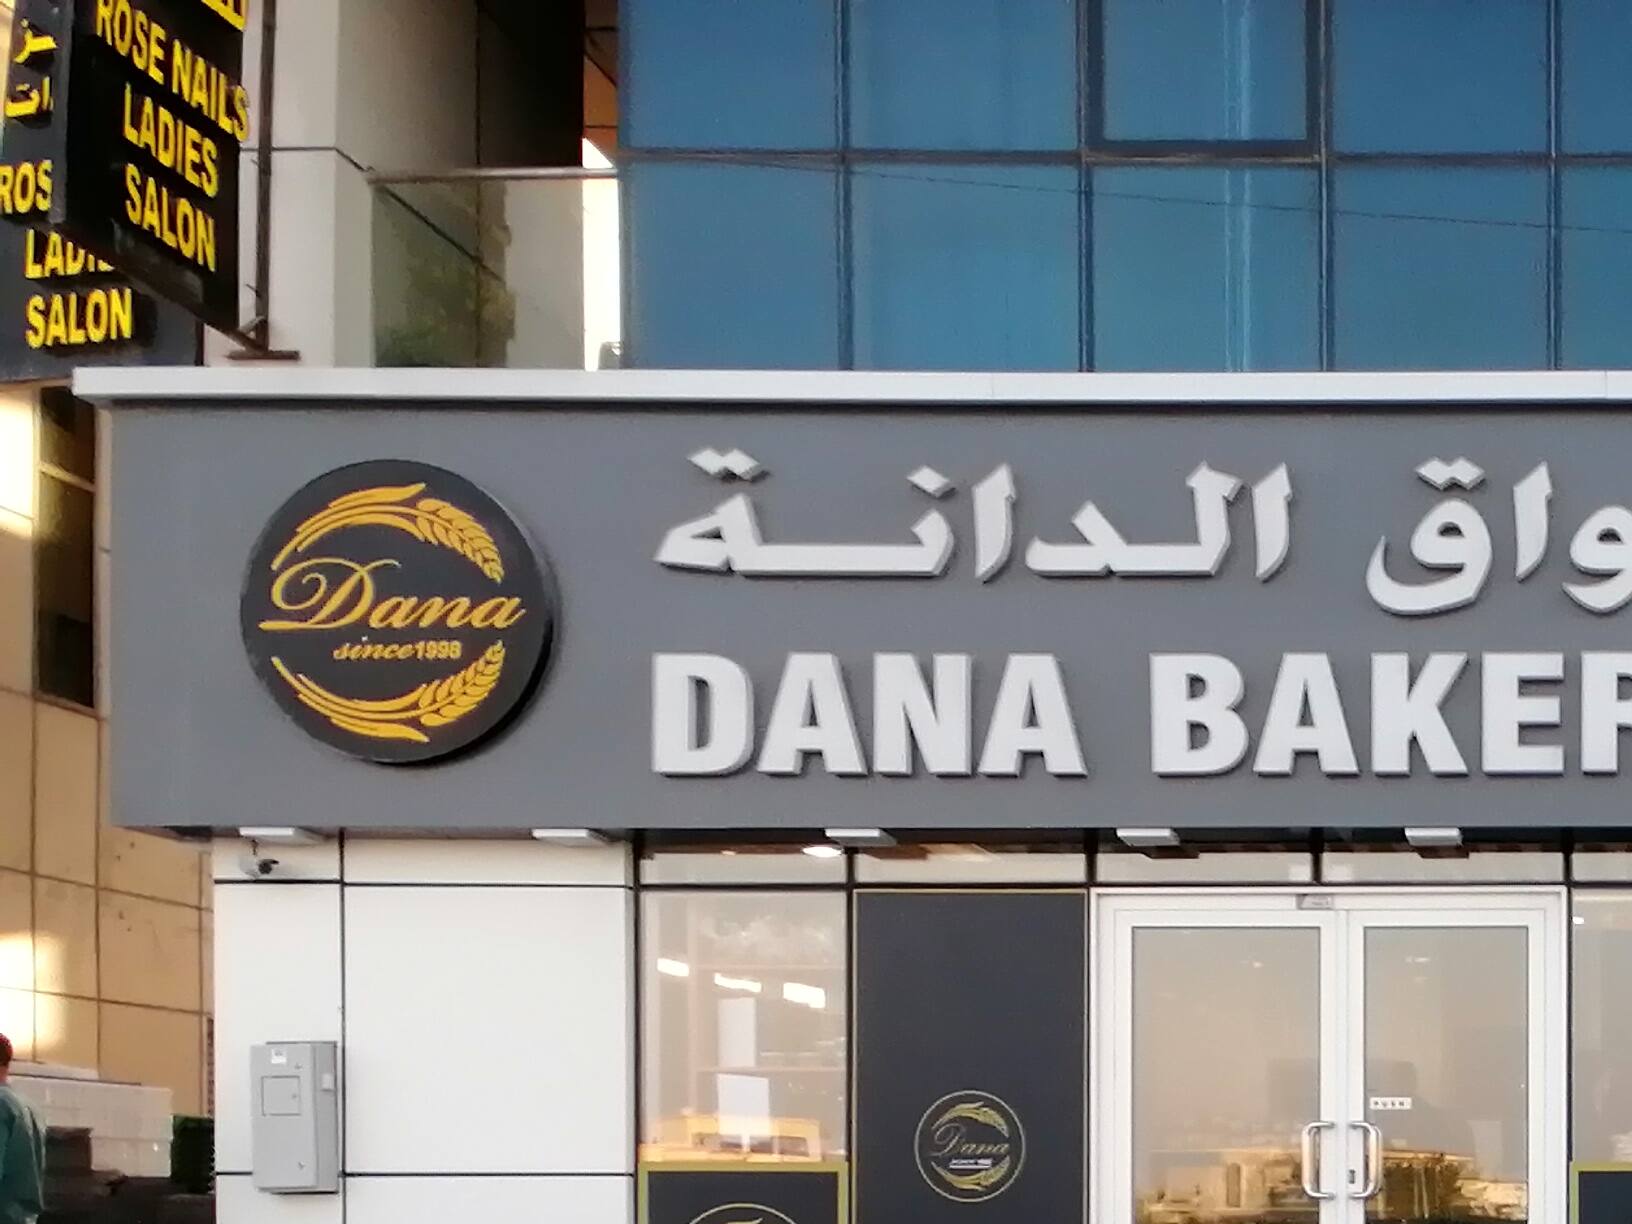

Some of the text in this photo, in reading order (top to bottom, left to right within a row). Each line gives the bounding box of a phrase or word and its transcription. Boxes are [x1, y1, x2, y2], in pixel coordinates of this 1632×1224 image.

[95, 0, 166, 84] ROSE
[171, 39, 249, 142] NAILS
[124, 82, 219, 198] LADIES
[125, 162, 217, 272] SALON
[25, 287, 132, 349] SALON
[655, 447, 1293, 583] الدانة
[258, 557, 526, 631] Dana
[651, 652, 1089, 778] DANA
